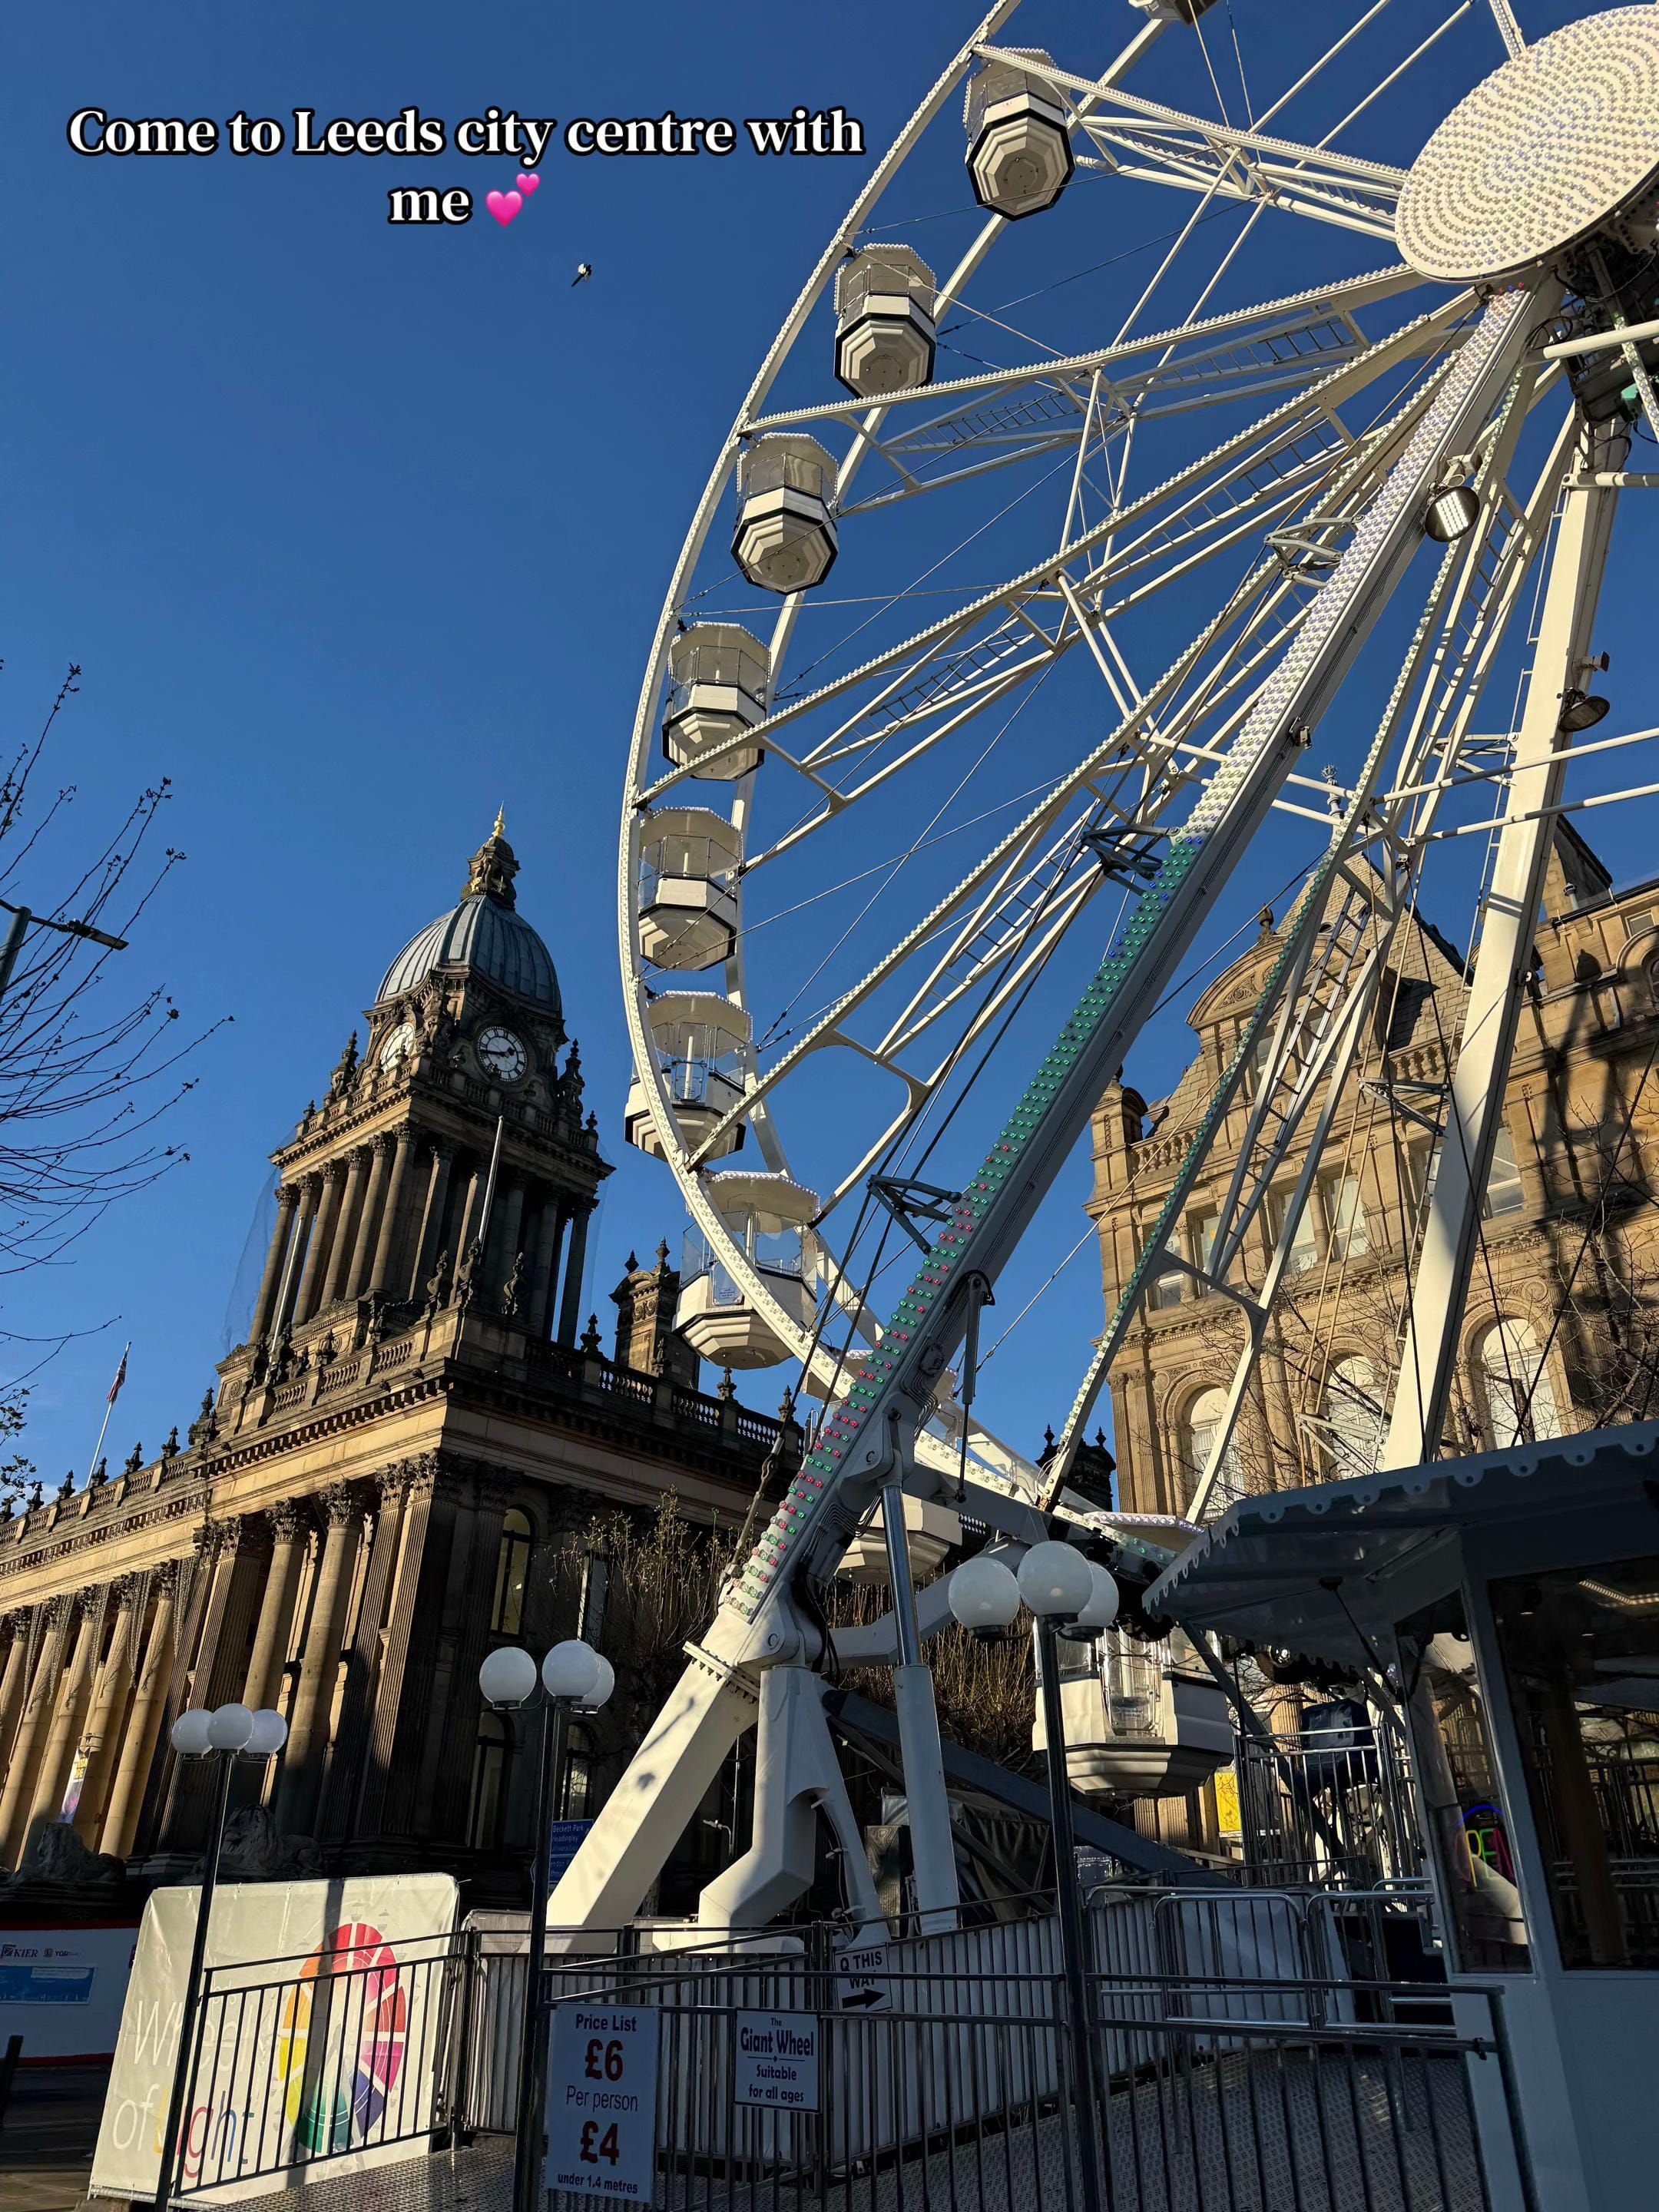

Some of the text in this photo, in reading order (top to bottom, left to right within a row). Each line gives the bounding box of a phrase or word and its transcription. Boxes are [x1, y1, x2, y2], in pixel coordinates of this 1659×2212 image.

[552, 1825, 571, 1833] Beckett
[14, 1948, 38, 1958] KIER
[840, 1951, 882, 1972] Q THIS
[576, 2013, 637, 2032] Price List
[770, 2017, 783, 2026] The
[740, 2026, 814, 2056] Giant Wheel
[584, 2038, 624, 2081] £6
[757, 2064, 797, 2081] Suitable
[565, 2085, 638, 2113] Per person
[749, 2083, 804, 2103] for all ages
[112, 2084, 161, 2151] of
[580, 2121, 620, 2166] £4
[558, 2172, 638, 2194] under 1.4 metres
